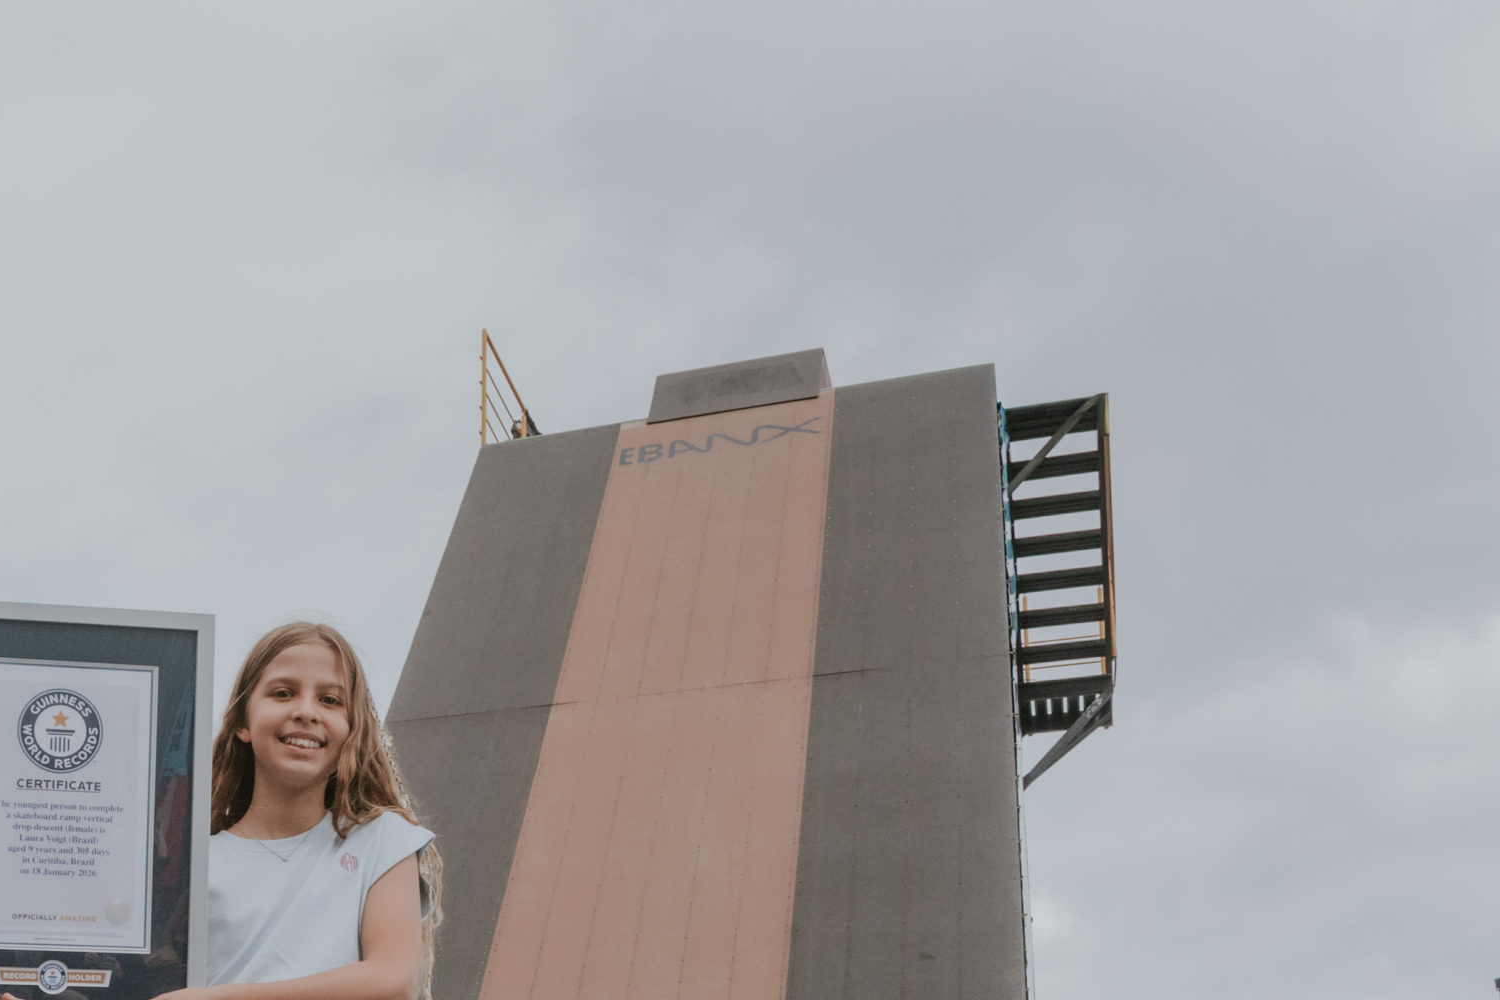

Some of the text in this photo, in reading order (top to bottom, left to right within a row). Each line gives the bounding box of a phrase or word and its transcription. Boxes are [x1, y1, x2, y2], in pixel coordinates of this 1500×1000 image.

[619, 416, 823, 466] EBANX
[30, 694, 92, 717] GUINNESS
[22, 724, 98, 768] WORLD RECORDS
[17, 779, 101, 791] CERTIFICATE
[13, 801, 48, 810] youngest
[89, 805, 124, 813] complete
[13, 812, 57, 820] skateboard
[13, 823, 32, 832] drop
[34, 823, 63, 832] descent
[65, 825, 98, 833] (female)
[46, 835, 66, 844] Voigt
[69, 836, 99, 844] (Brazil)
[92, 848, 110, 857] days
[32, 856, 68, 866] Curitiba,
[71, 858, 94, 866] Brazil
[43, 868, 76, 878] January
[78, 869, 97, 877] 2026
